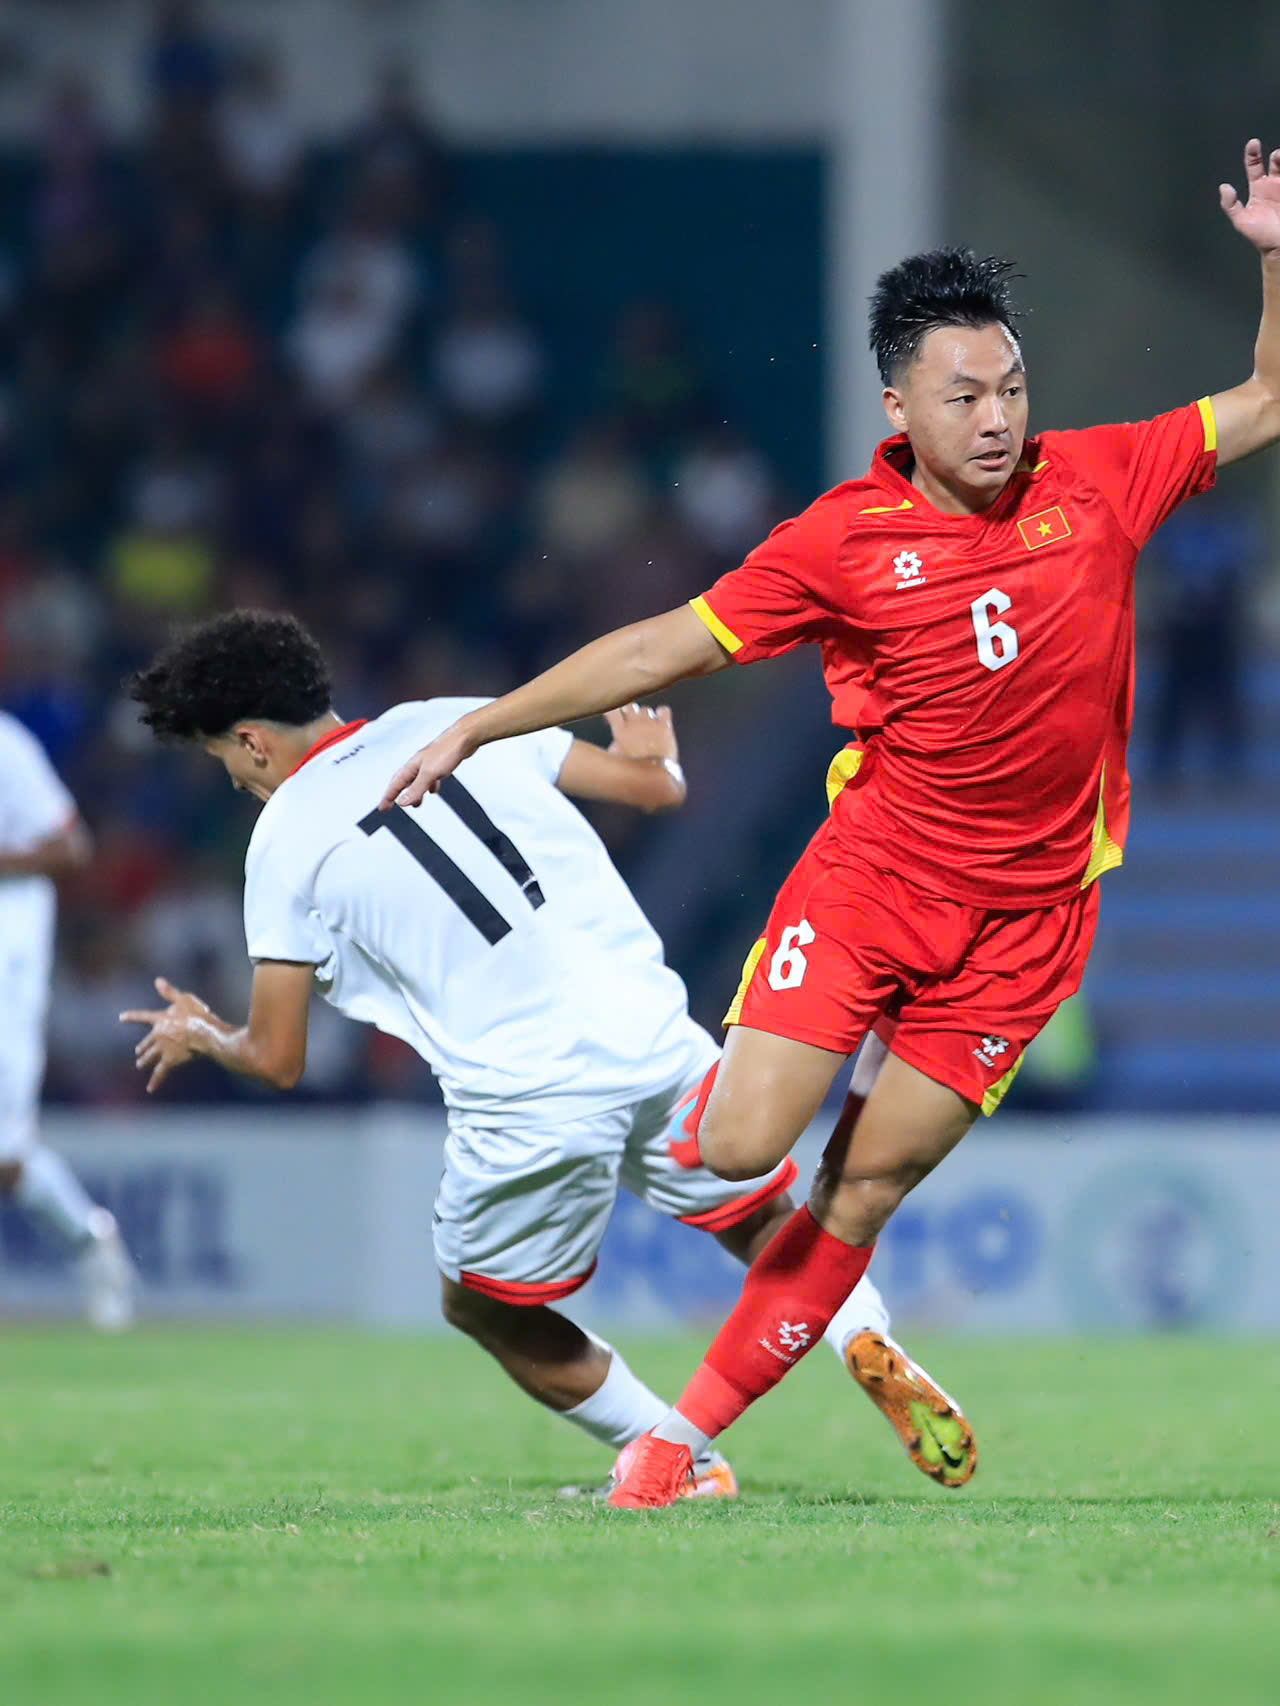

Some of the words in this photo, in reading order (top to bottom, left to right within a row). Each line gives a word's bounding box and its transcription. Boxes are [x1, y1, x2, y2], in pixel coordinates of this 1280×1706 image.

[970, 587, 1018, 672] 6
[357, 774, 546, 946] 11
[767, 919, 816, 991] 6
